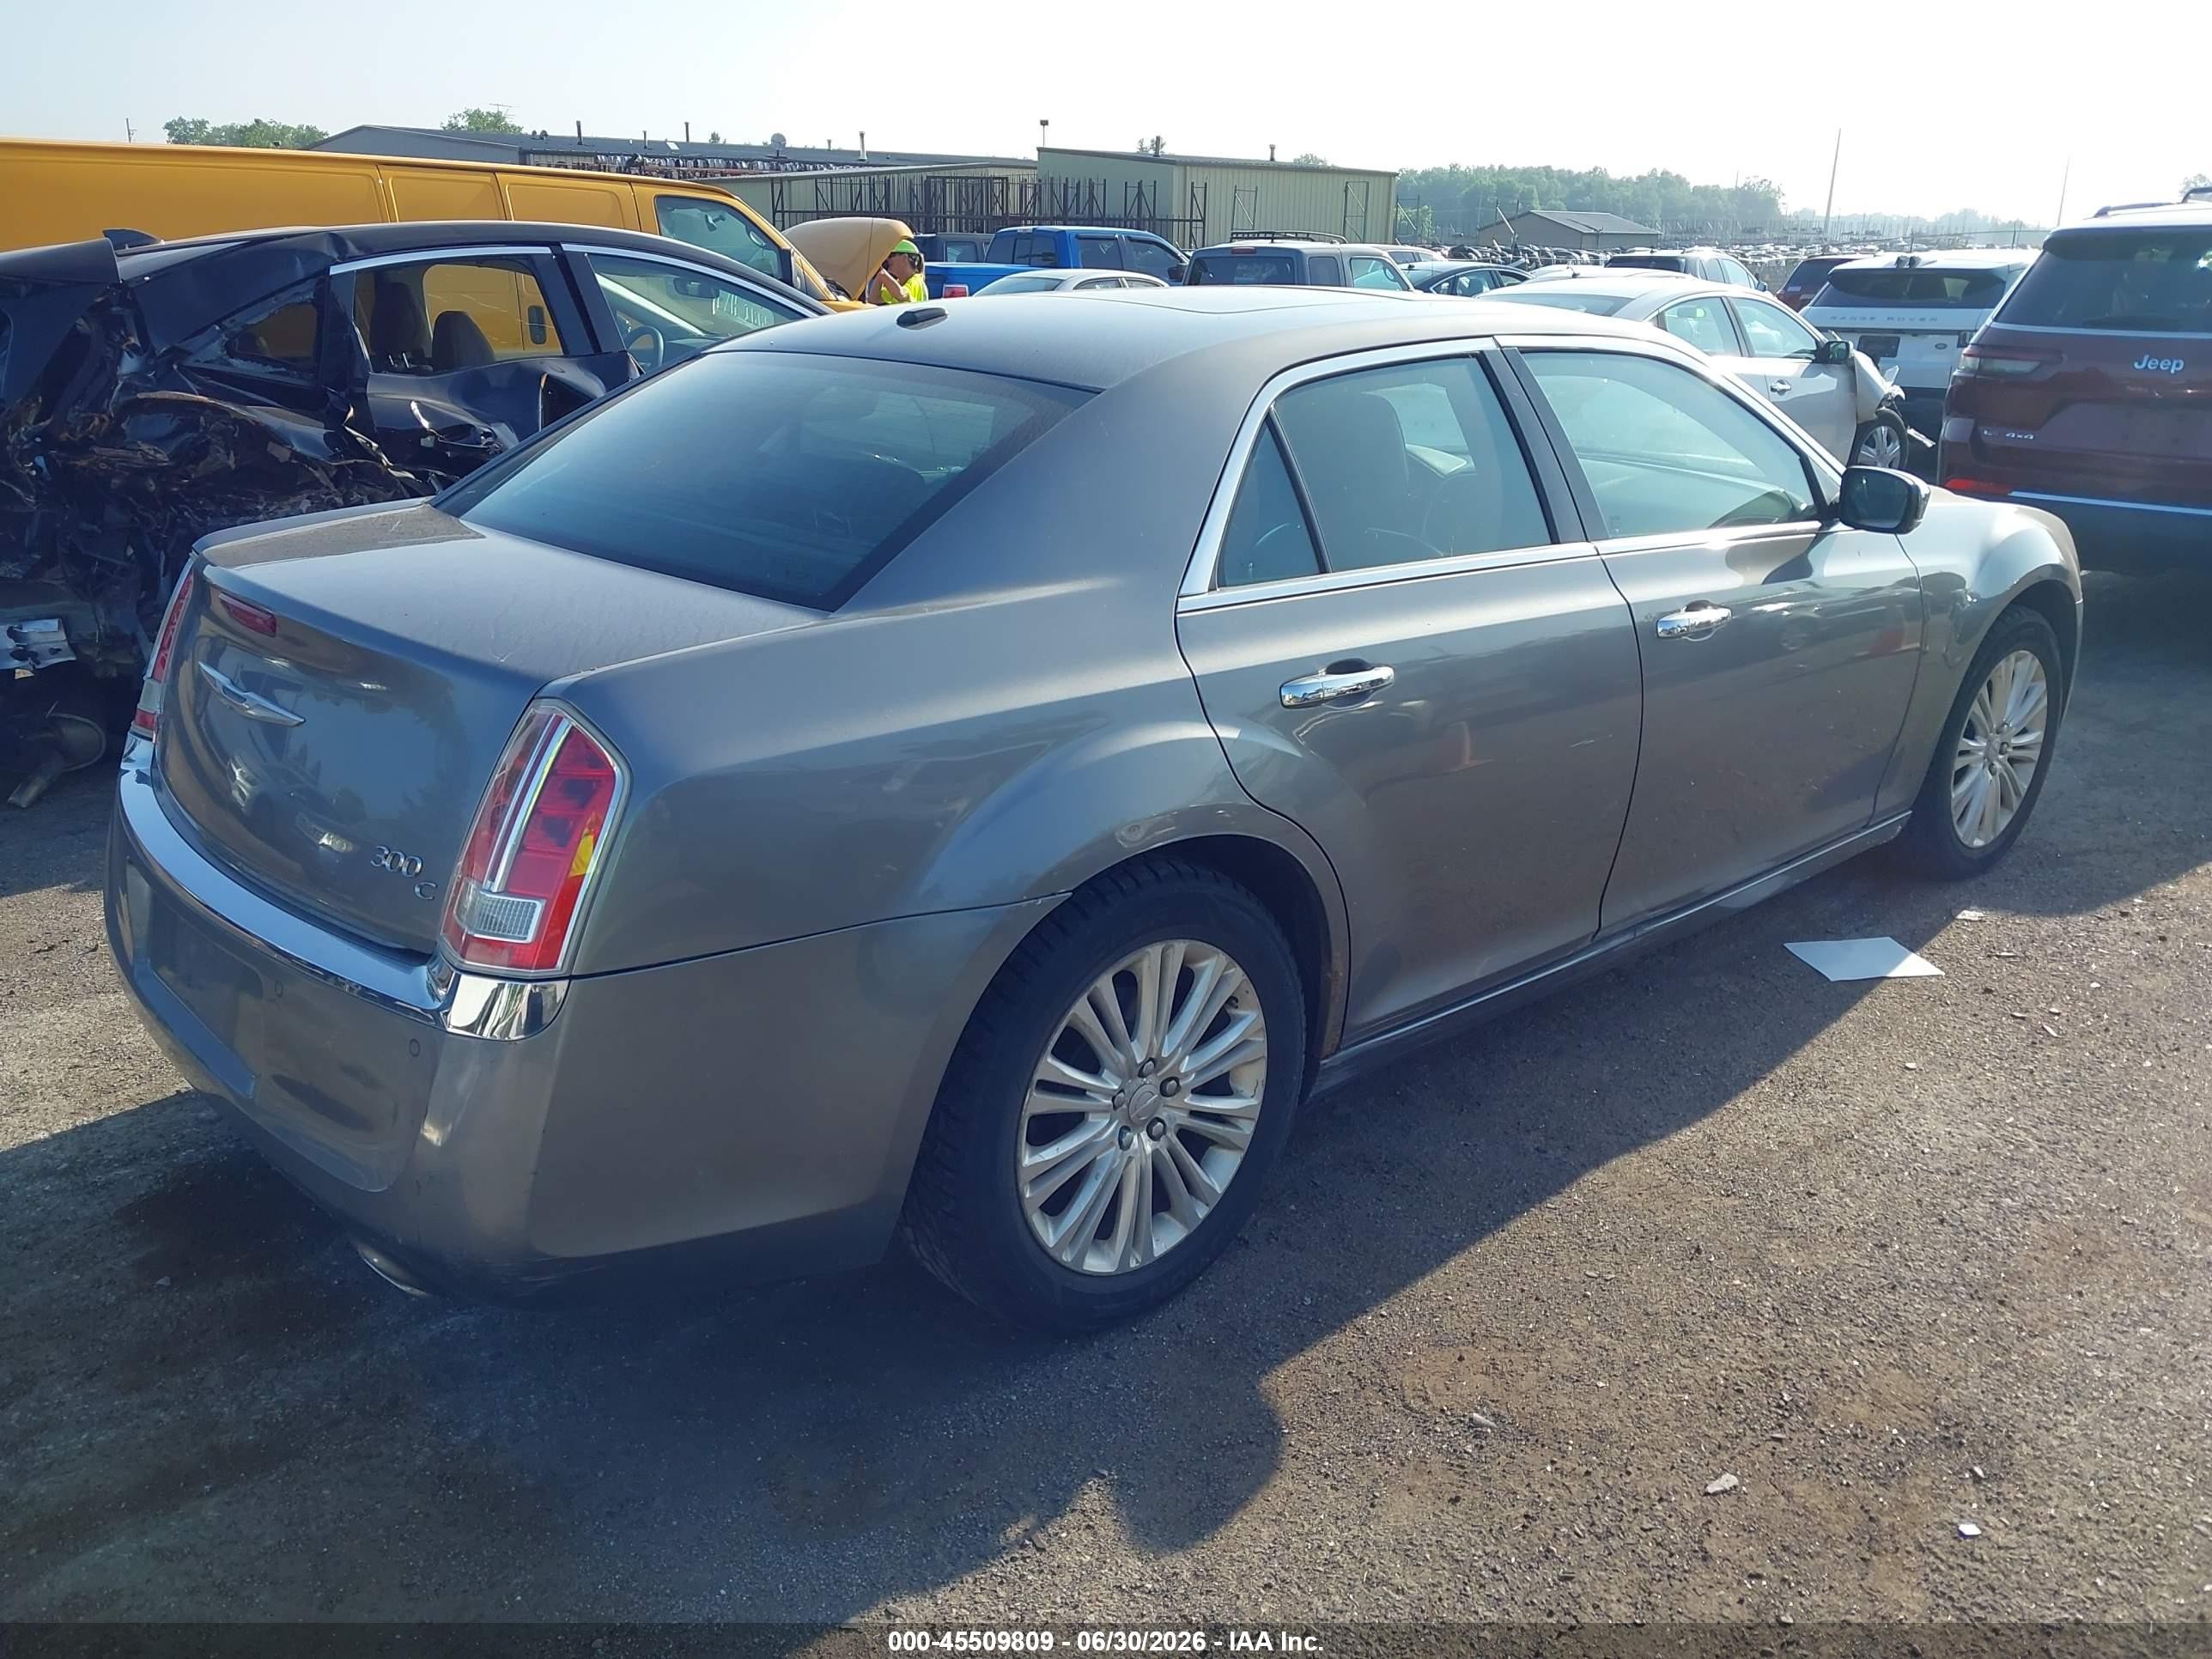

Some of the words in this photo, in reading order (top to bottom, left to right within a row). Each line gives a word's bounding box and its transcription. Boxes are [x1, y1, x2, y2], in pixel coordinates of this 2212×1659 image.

[2134, 355, 2185, 374] Jeep
[370, 845, 423, 878] 300
[414, 881, 438, 901] C
